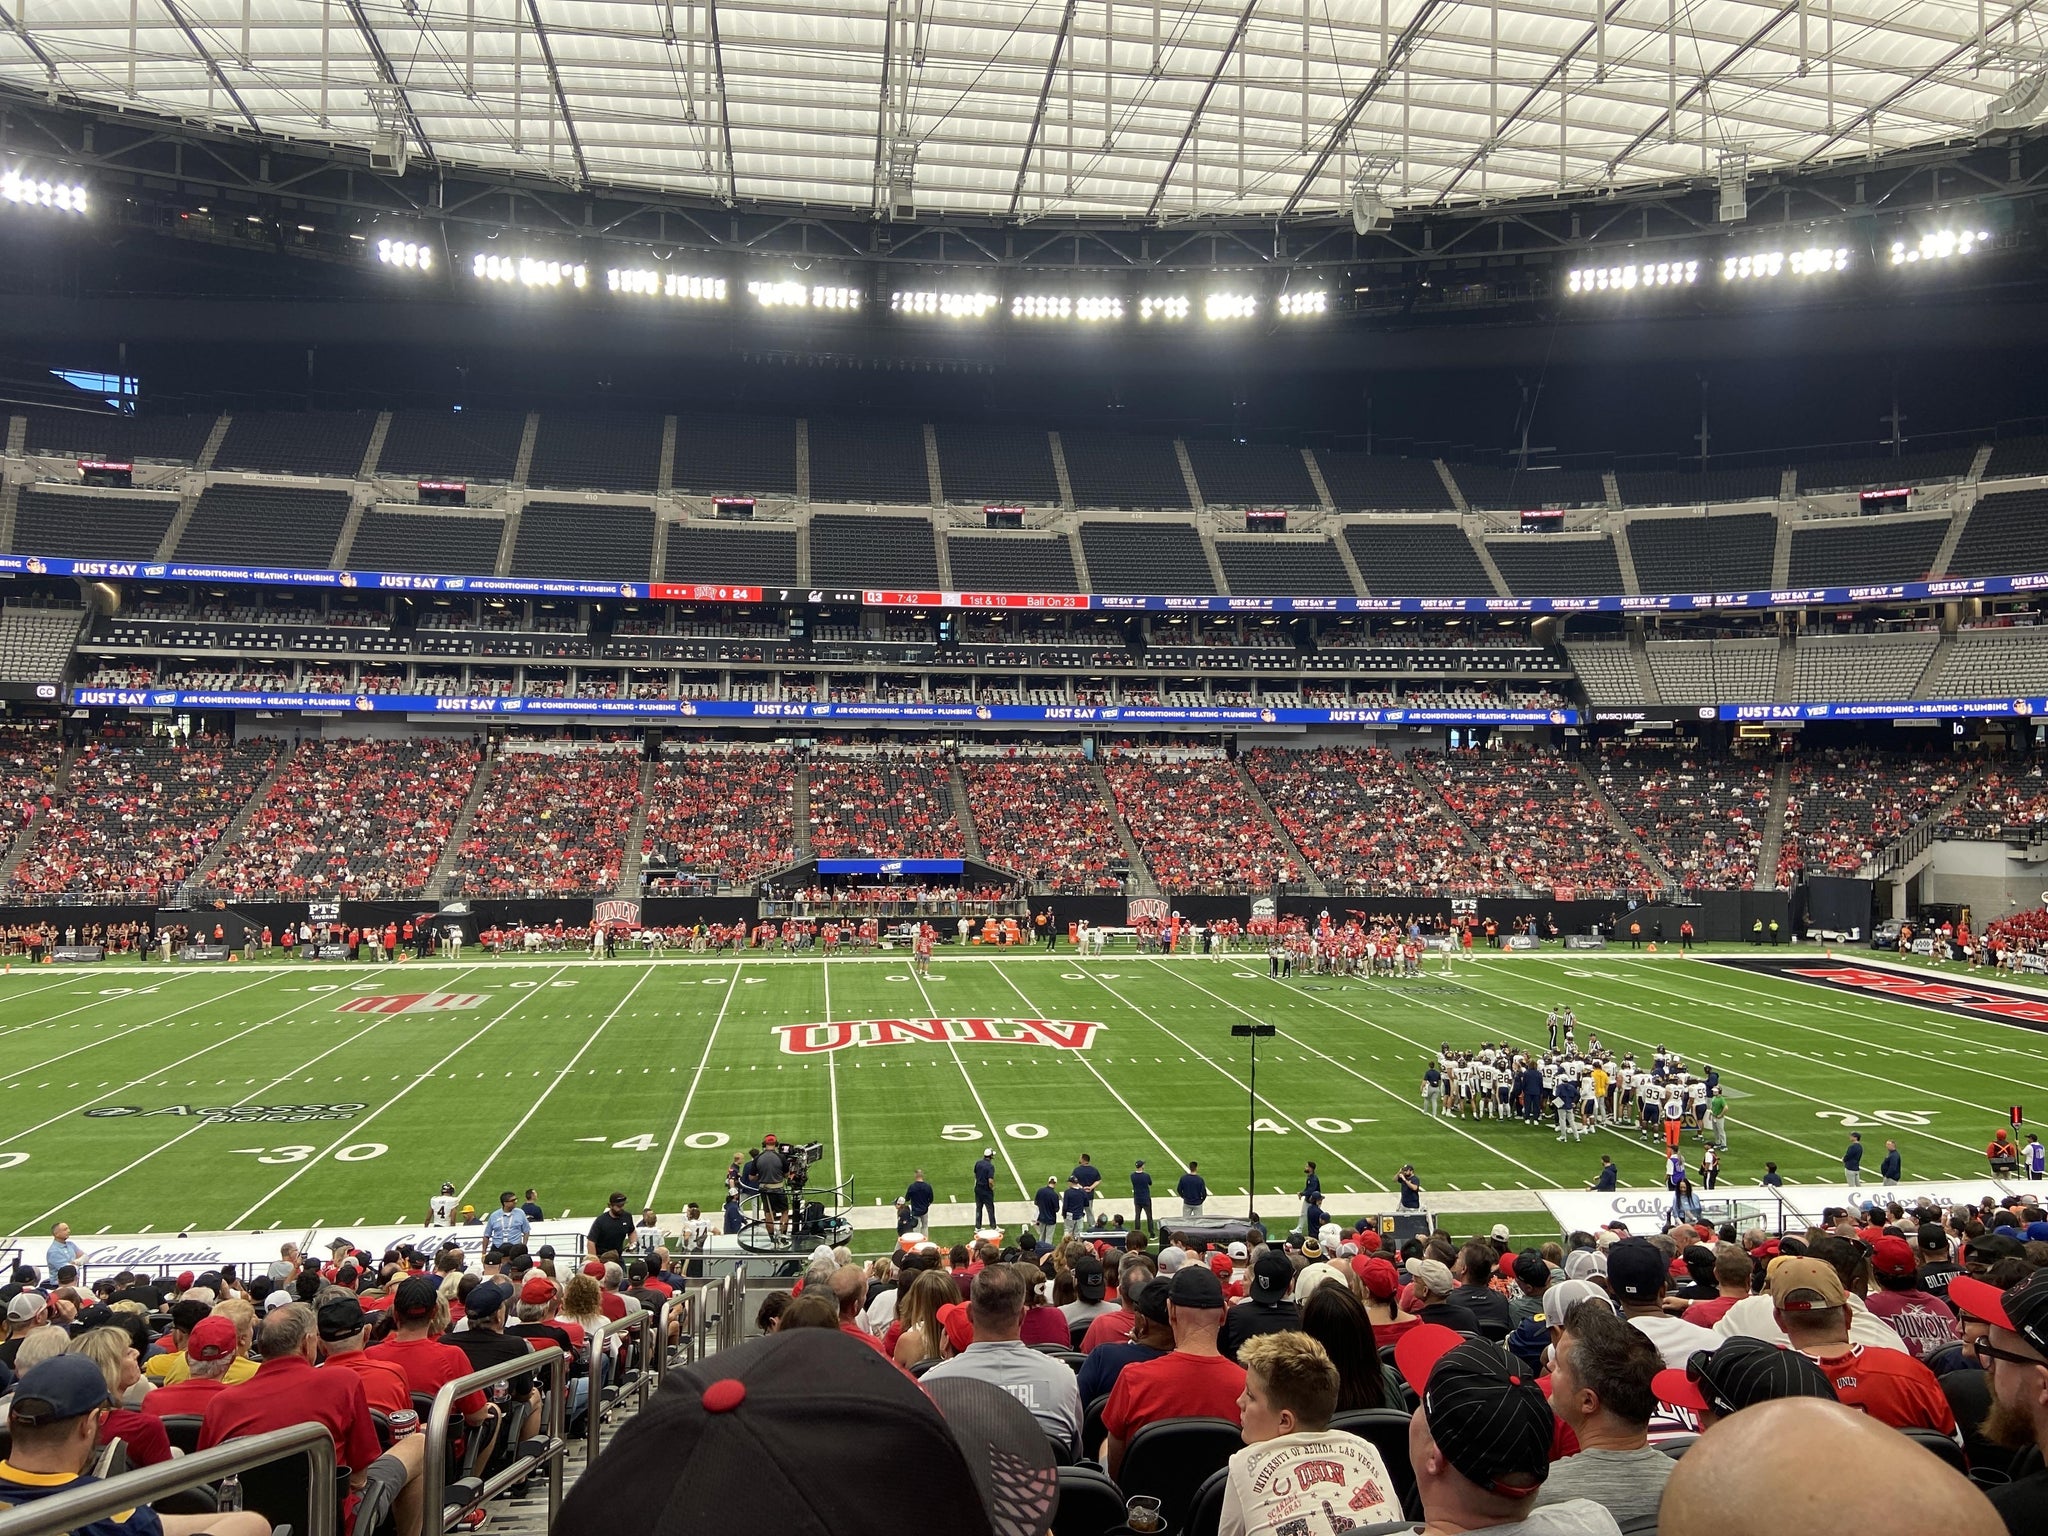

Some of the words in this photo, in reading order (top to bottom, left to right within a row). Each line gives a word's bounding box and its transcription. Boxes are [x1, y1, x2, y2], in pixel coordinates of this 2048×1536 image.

[72, 563, 107, 575] JUST
[109, 564, 137, 576] SAY
[143, 565, 165, 576] YES!
[172, 568, 186, 576] AIR
[187, 569, 248, 579] CONDITIONING
[253, 571, 288, 580] HEATING
[294, 573, 335, 582] PLUMBING
[380, 576, 412, 588] JUST
[413, 578, 438, 589] SAY
[444, 578, 464, 590] YES!
[484, 582, 539, 590] CONDITIONING
[543, 584, 575, 592] HEATING
[1928, 583, 1950, 592] JUST
[1951, 581, 1968, 590] SAY
[2011, 577, 2033, 587] JUST
[719, 590, 726, 598] 0
[733, 590, 748, 599] 24
[780, 591, 788, 600] 7
[808, 591, 822, 602] Cal
[867, 592, 882, 602] Q3
[897, 594, 918, 603] 7:42
[1771, 592, 1791, 601] JUST
[1792, 591, 1809, 599] SAY
[1849, 589, 1870, 597] JUST
[1871, 587, 1888, 596] SAY
[969, 596, 984, 606] 1st
[985, 596, 993, 606] &
[996, 596, 1007, 606] 10
[1027, 597, 1046, 607] Ball
[1047, 597, 1062, 607] On
[1064, 598, 1076, 607] 23
[1165, 598, 1182, 606] JUST
[1292, 599, 1309, 607] JUST
[1620, 598, 1640, 606] JUST
[39, 687, 54, 697] CC
[80, 692, 116, 704] JUST
[118, 693, 146, 704] SAY
[153, 693, 176, 704] YES!
[199, 697, 261, 705] CONDITIONING
[267, 698, 303, 706] HEATING
[309, 698, 350, 706] PLUMBING
[436, 698, 469, 710] JUST
[471, 699, 495, 710] SAY
[502, 700, 521, 711] YES!
[602, 703, 634, 711] HEATING
[639, 703, 676, 711] PLUMBING
[753, 703, 782, 715] JUST
[784, 704, 807, 715] SAY
[812, 704, 831, 716] YES!
[1045, 708, 1072, 718] JUST
[1074, 709, 1096, 718] SAY
[1101, 709, 1118, 719] YES!
[1701, 708, 1714, 717] CC
[1737, 706, 1770, 717] JUST
[1773, 706, 1800, 717] SAY
[1807, 705, 1828, 717] YES!
[1835, 706, 1850, 714] AIR
[1851, 705, 1914, 714] CONDITIONING
[1919, 704, 1957, 712] HEATING
[1964, 703, 2008, 712] PLUMBING
[1329, 711, 1357, 721] JUST
[1358, 711, 1381, 721] SAY
[1386, 711, 1403, 721] YES!
[1596, 712, 1622, 721] (MUSIC)
[1623, 712, 1645, 720] MUSIC
[309, 904, 340, 915] PT'S
[1451, 900, 1477, 909] PT'S
[595, 900, 640, 925] UNLV
[1128, 899, 1169, 922] UNLV
[771, 1017, 1110, 1055] UNLV
[1458, 1072, 1469, 1082] 17
[1480, 1070, 1492, 1081] 38
[1541, 1068, 1552, 1078] 19
[1569, 1067, 1576, 1076] 6
[1498, 1074, 1509, 1083] 28
[1625, 1075, 1632, 1084] 3
[1646, 1088, 1660, 1100] 93
[137, 1102, 368, 1117] Acesso
[200, 1112, 357, 1123] Biologics
[437, 1206, 446, 1219] 4
[641, 1234, 654, 1249] 11
[694, 1227, 708, 1248] 14
[1892, 1313, 1954, 1341] DUMONT
[1836, 1376, 1857, 1390] UNLV
[999, 1384, 1040, 1408] TBL
[1253, 1451, 1290, 1494] UNIVERSITY
[1291, 1446, 1301, 1457] OF
[1339, 1445, 1355, 1458] LAS
[1358, 1452, 1380, 1479] VEGAS
[1294, 1460, 1346, 1492] UNLV
